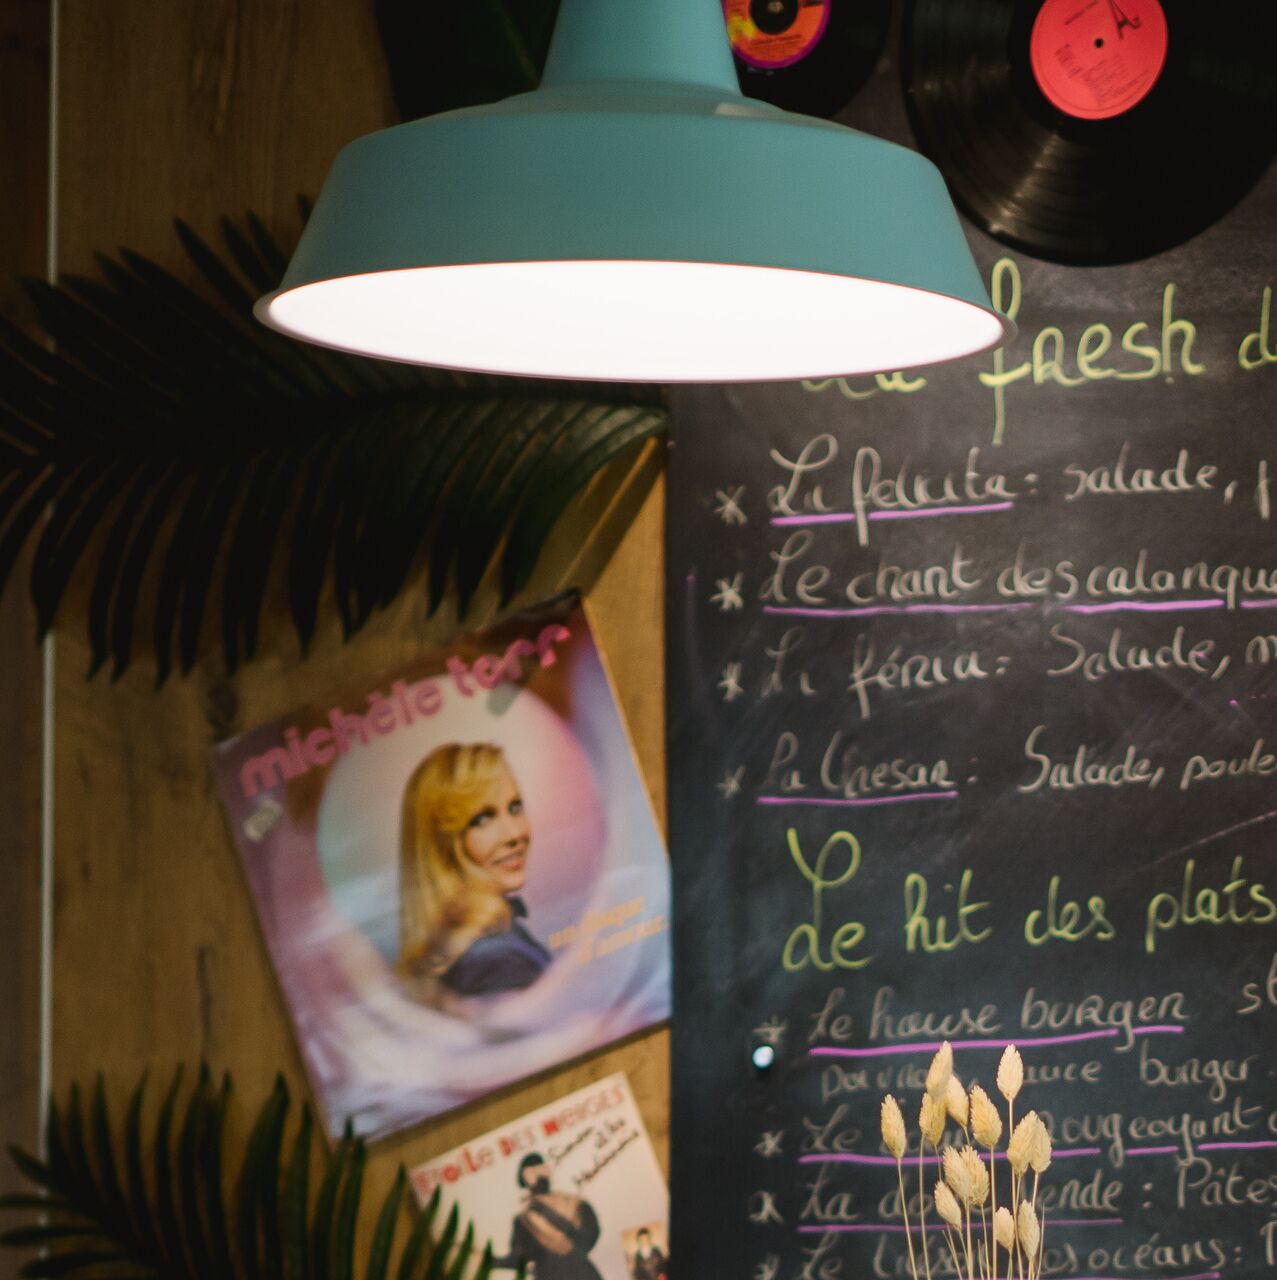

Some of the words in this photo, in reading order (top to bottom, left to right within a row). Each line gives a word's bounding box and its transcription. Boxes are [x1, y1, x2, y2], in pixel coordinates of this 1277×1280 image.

[979, 256, 1206, 446] fresh
[1064, 441, 1240, 506] salade,
[758, 530, 832, 602] Le
[846, 543, 984, 602] chant
[996, 545, 1074, 600] des
[1047, 622, 1230, 680] Salade,
[1018, 724, 1167, 793] Salade,
[781, 826, 874, 971] Le
[903, 867, 995, 954] hit
[1023, 875, 1117, 947] des
[808, 986, 876, 1041] Le
[1020, 986, 1190, 1053] burger
